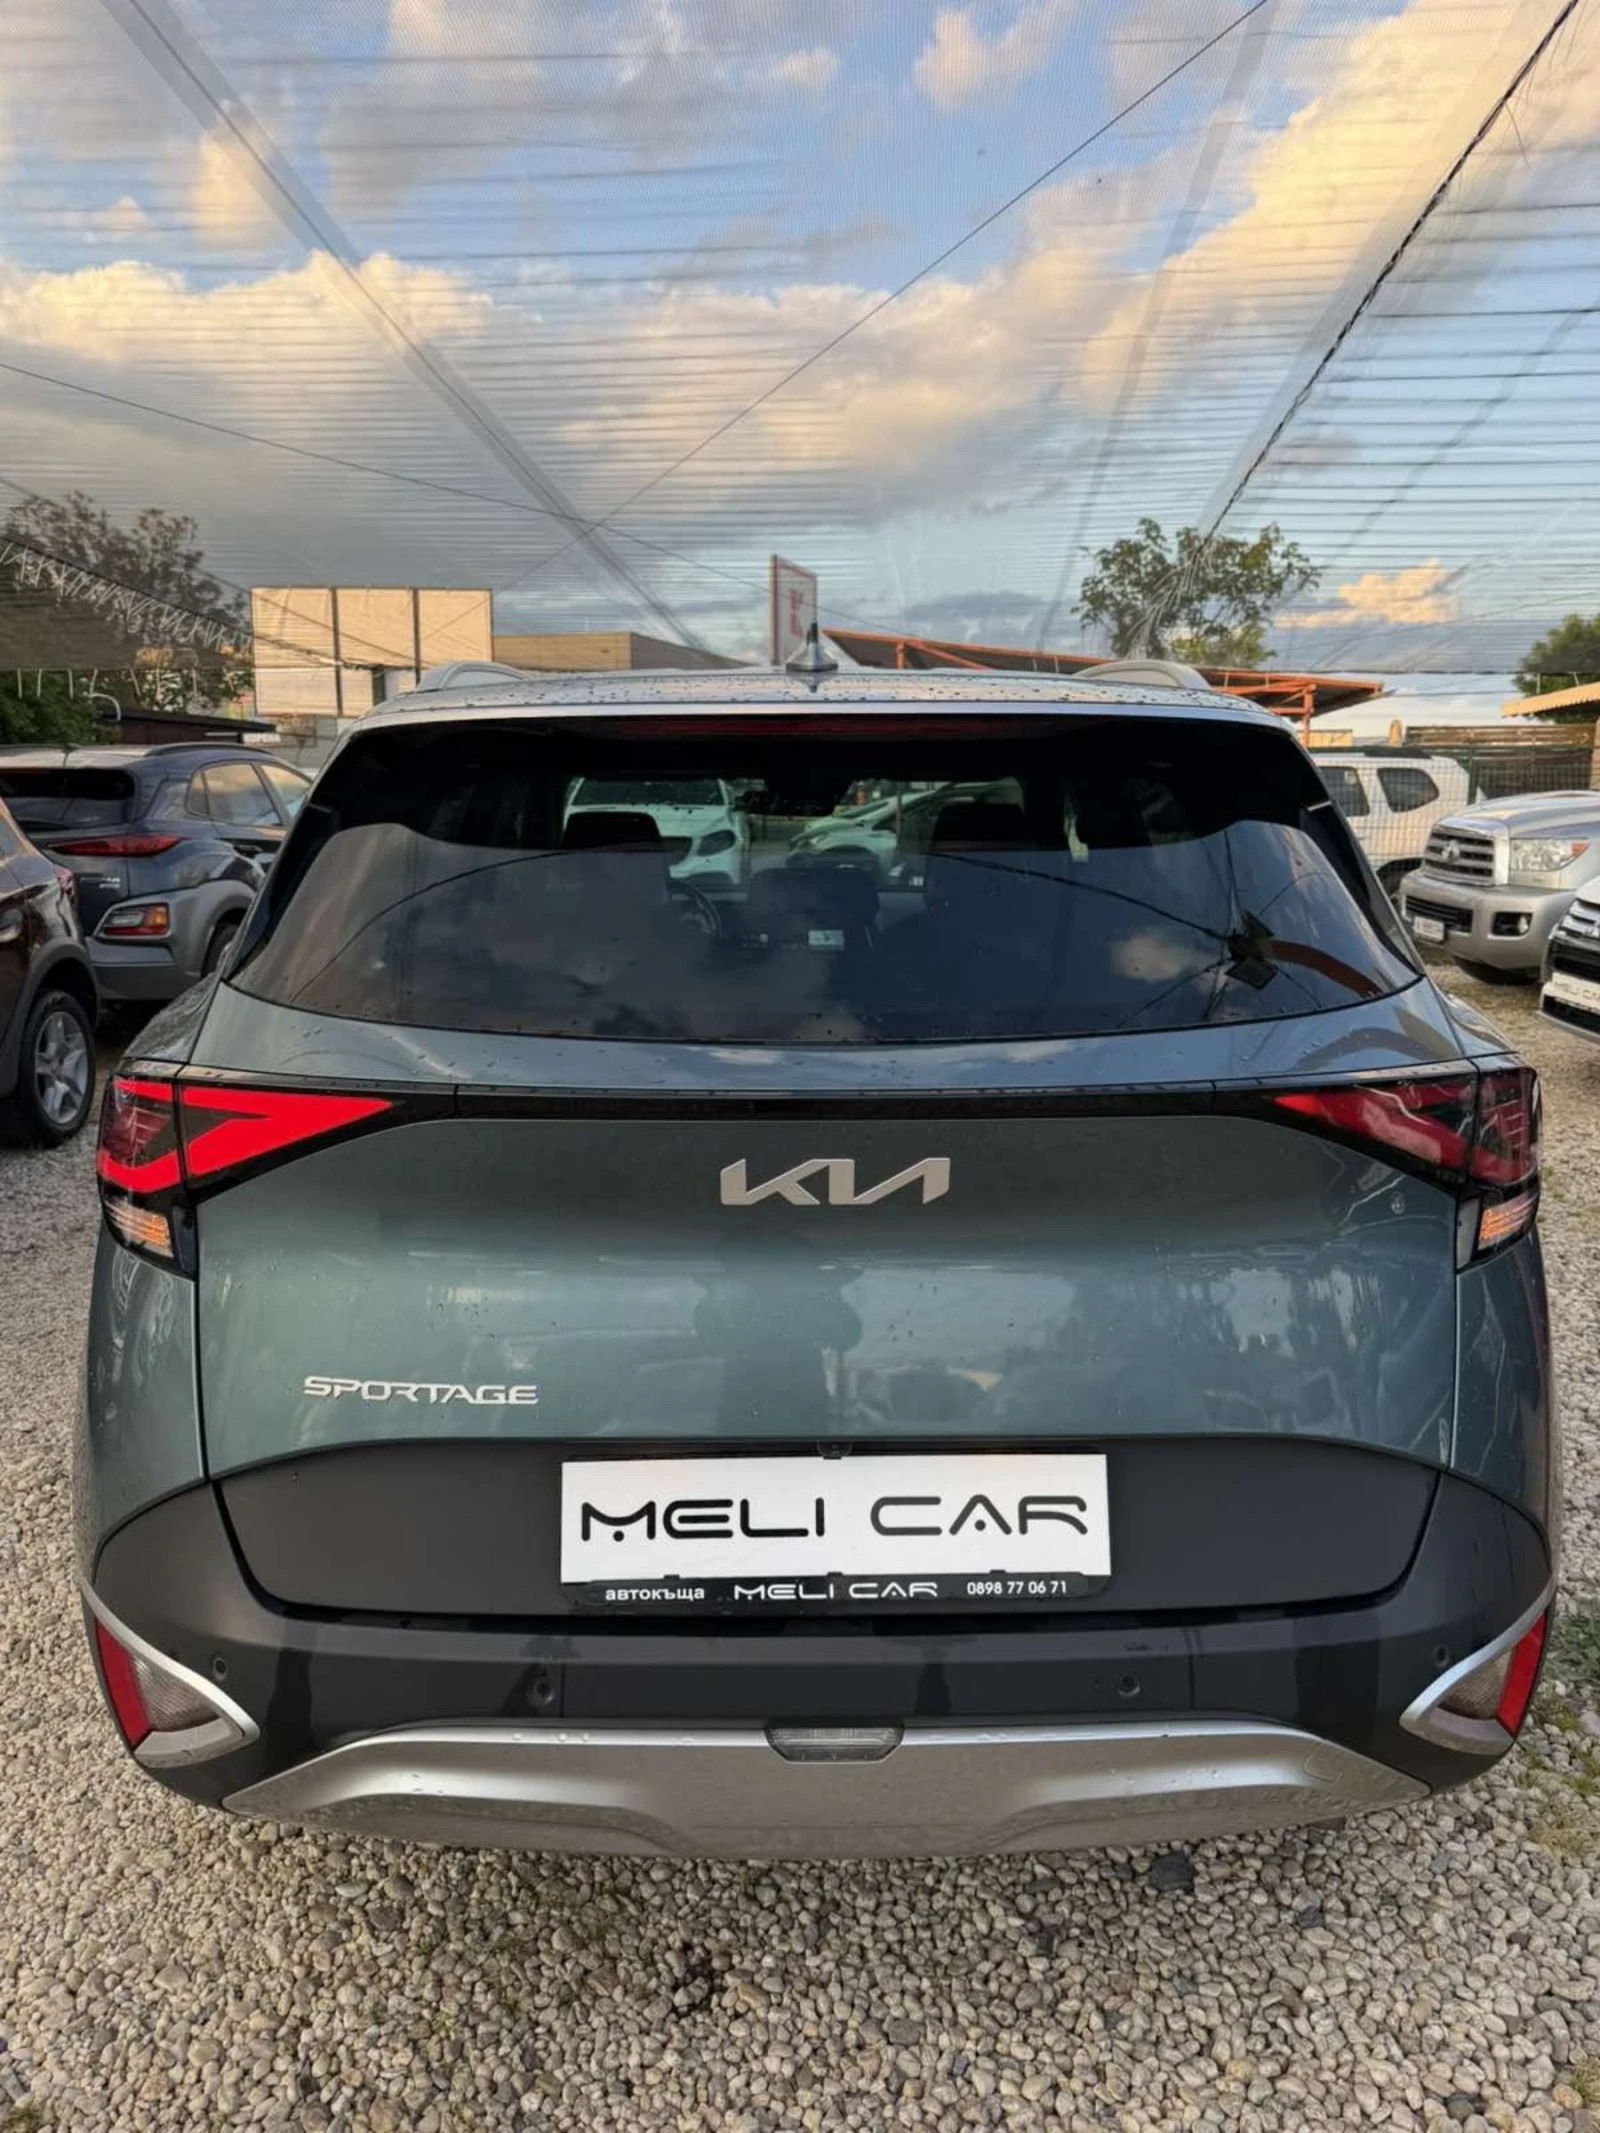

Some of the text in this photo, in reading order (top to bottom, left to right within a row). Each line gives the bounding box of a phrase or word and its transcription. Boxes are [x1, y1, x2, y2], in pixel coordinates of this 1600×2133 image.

[720, 1157, 950, 1205] KIA
[303, 1375, 539, 1405] SPORTAGE
[581, 1494, 1088, 1542] MELI CAR
[605, 1580, 1067, 1602] автокъща MELI CAR 0898 77 06 71
